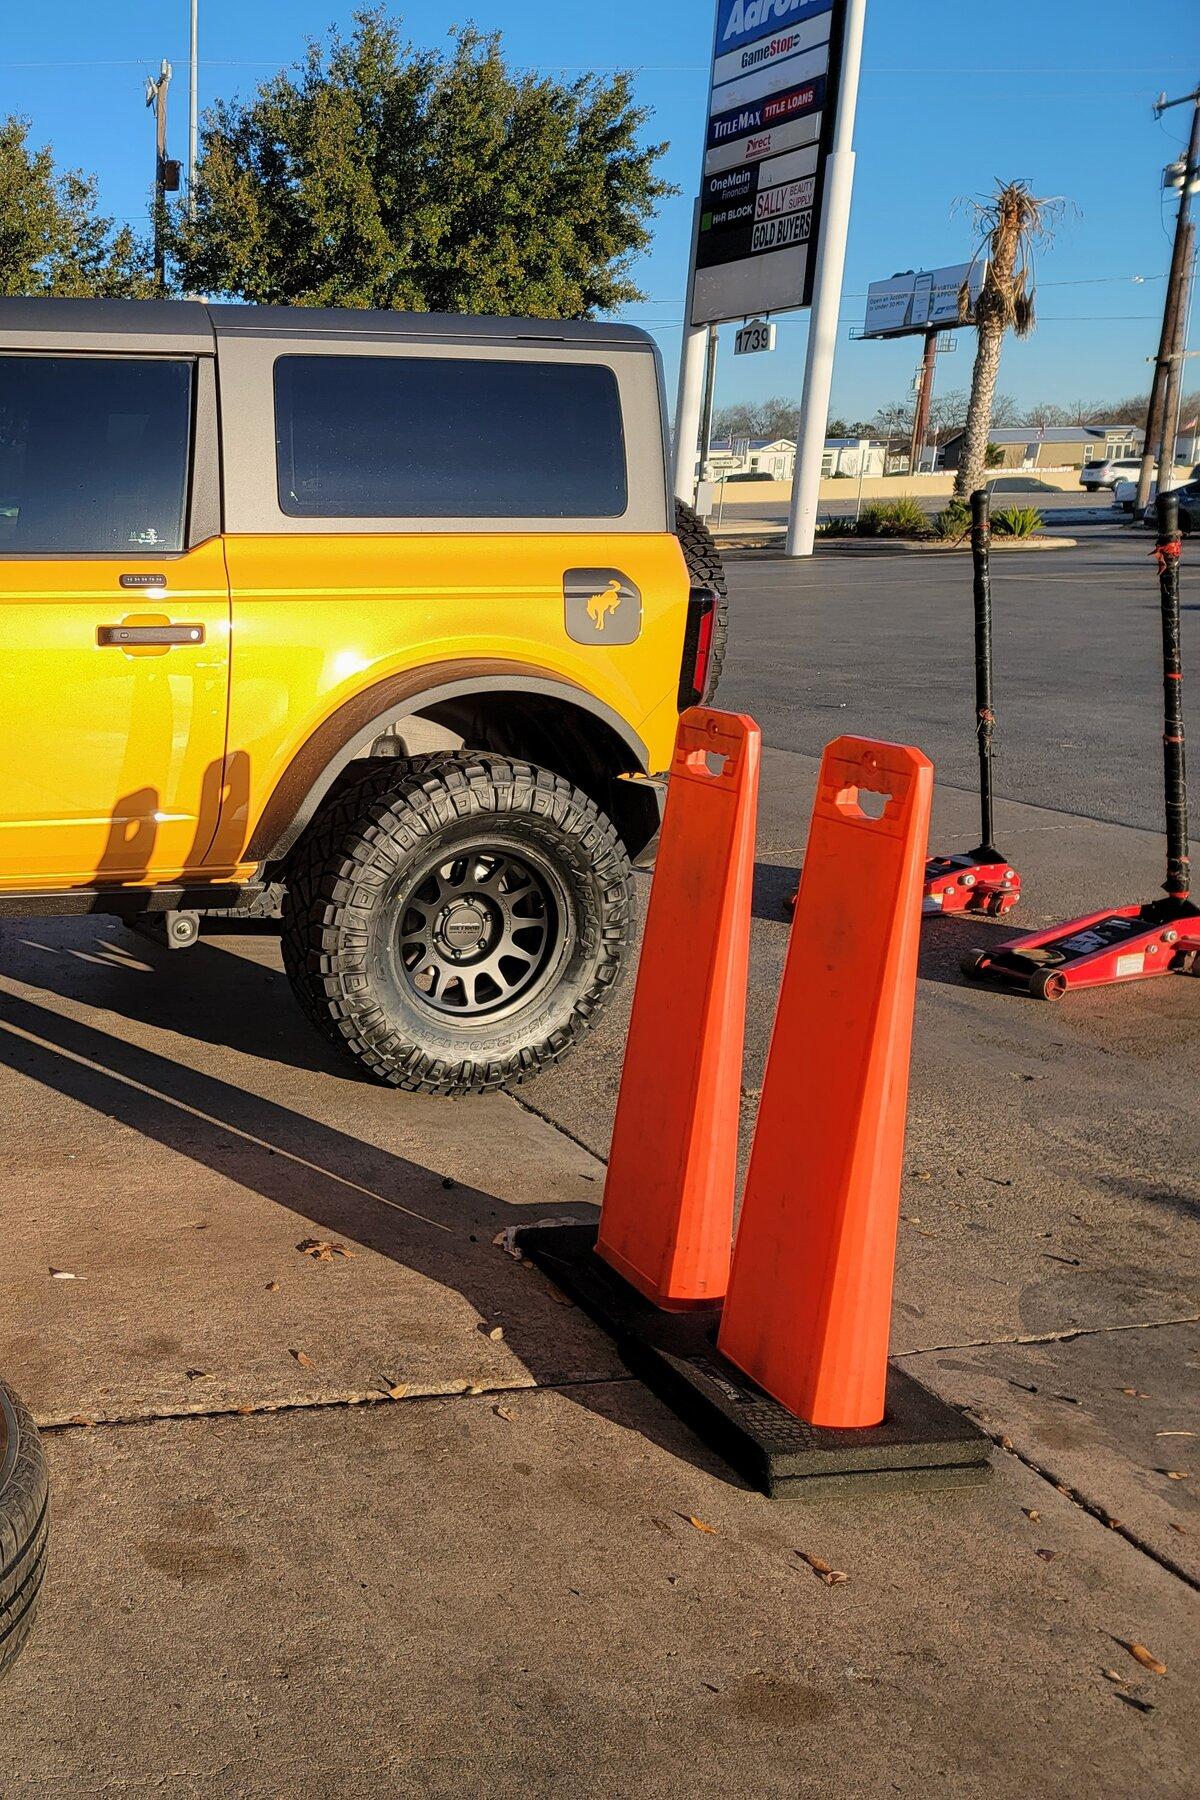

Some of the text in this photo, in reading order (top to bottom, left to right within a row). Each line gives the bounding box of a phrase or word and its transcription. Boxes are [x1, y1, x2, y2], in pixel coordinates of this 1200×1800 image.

[741, 35, 794, 68] GameStop
[765, 102, 786, 117] TITLE
[788, 90, 814, 110] LOANS
[709, 170, 751, 192] OneMain
[722, 183, 750, 199] Financial
[756, 181, 814, 218] SALLY BEAUTY
[788, 194, 813, 209] SUPPLY
[727, 204, 754, 221] BLOCK
[753, 213, 812, 249] GOLD BUYERS
[736, 327, 769, 352] 1739
